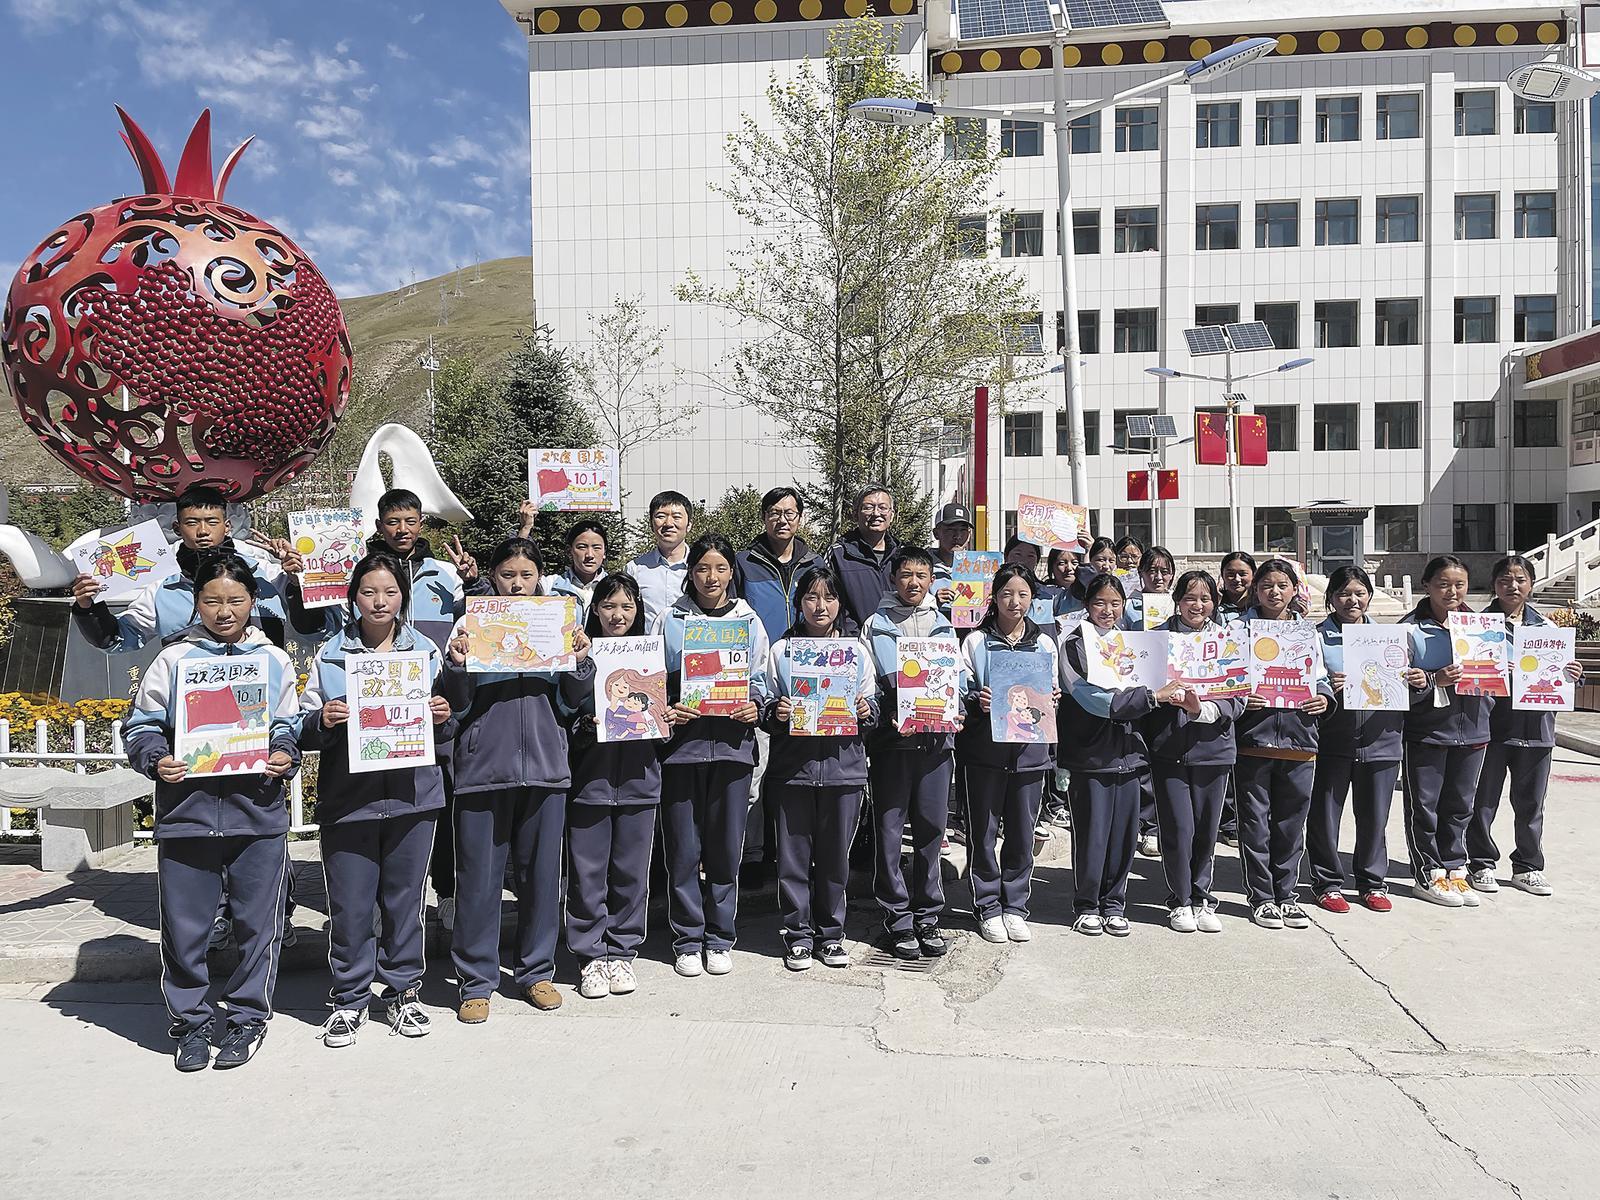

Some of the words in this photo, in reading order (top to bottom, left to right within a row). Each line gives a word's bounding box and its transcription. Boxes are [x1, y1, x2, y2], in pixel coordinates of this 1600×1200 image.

[574, 472, 597, 486] 10.1
[728, 651, 748, 665] 10.1
[389, 706, 410, 720] 10.1
